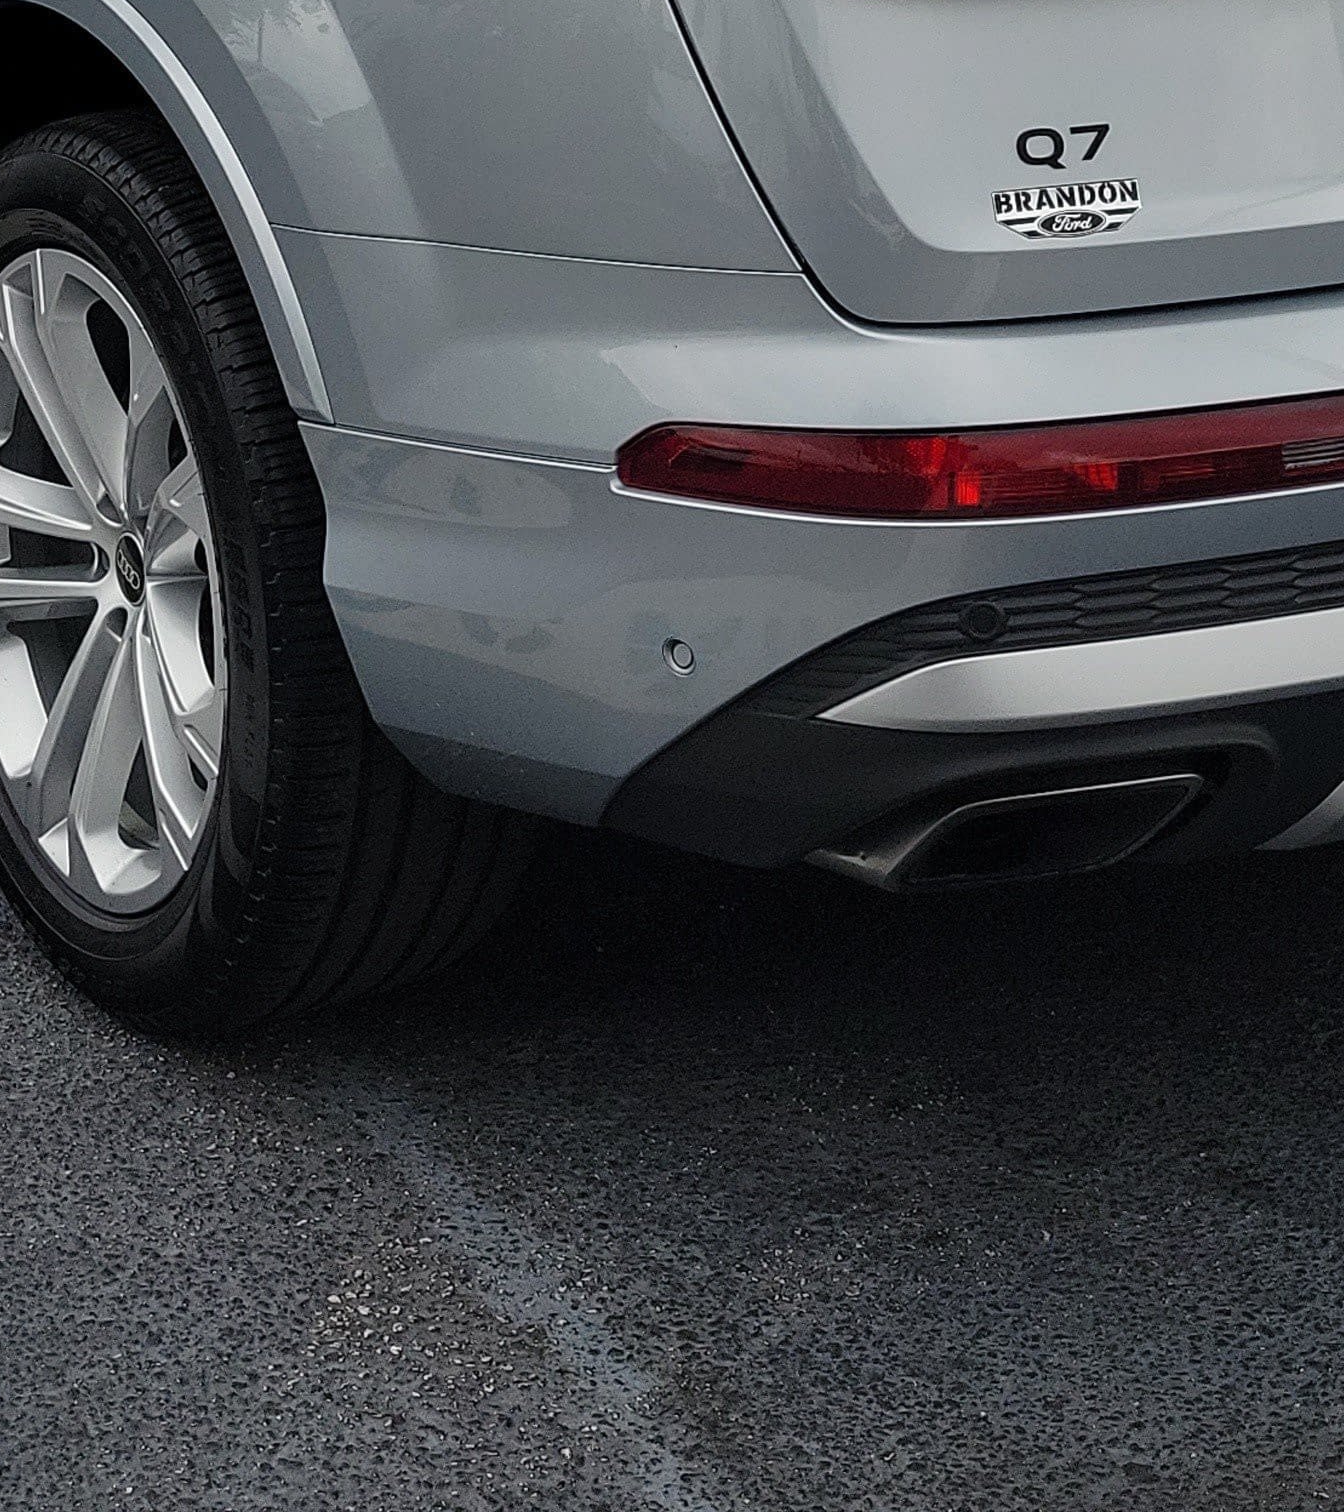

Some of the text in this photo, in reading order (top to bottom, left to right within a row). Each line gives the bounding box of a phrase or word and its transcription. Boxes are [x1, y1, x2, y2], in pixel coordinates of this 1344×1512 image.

[1016, 123, 1110, 170] Q7
[993, 182, 1139, 215] BRANDON
[1052, 213, 1092, 232] Ford
